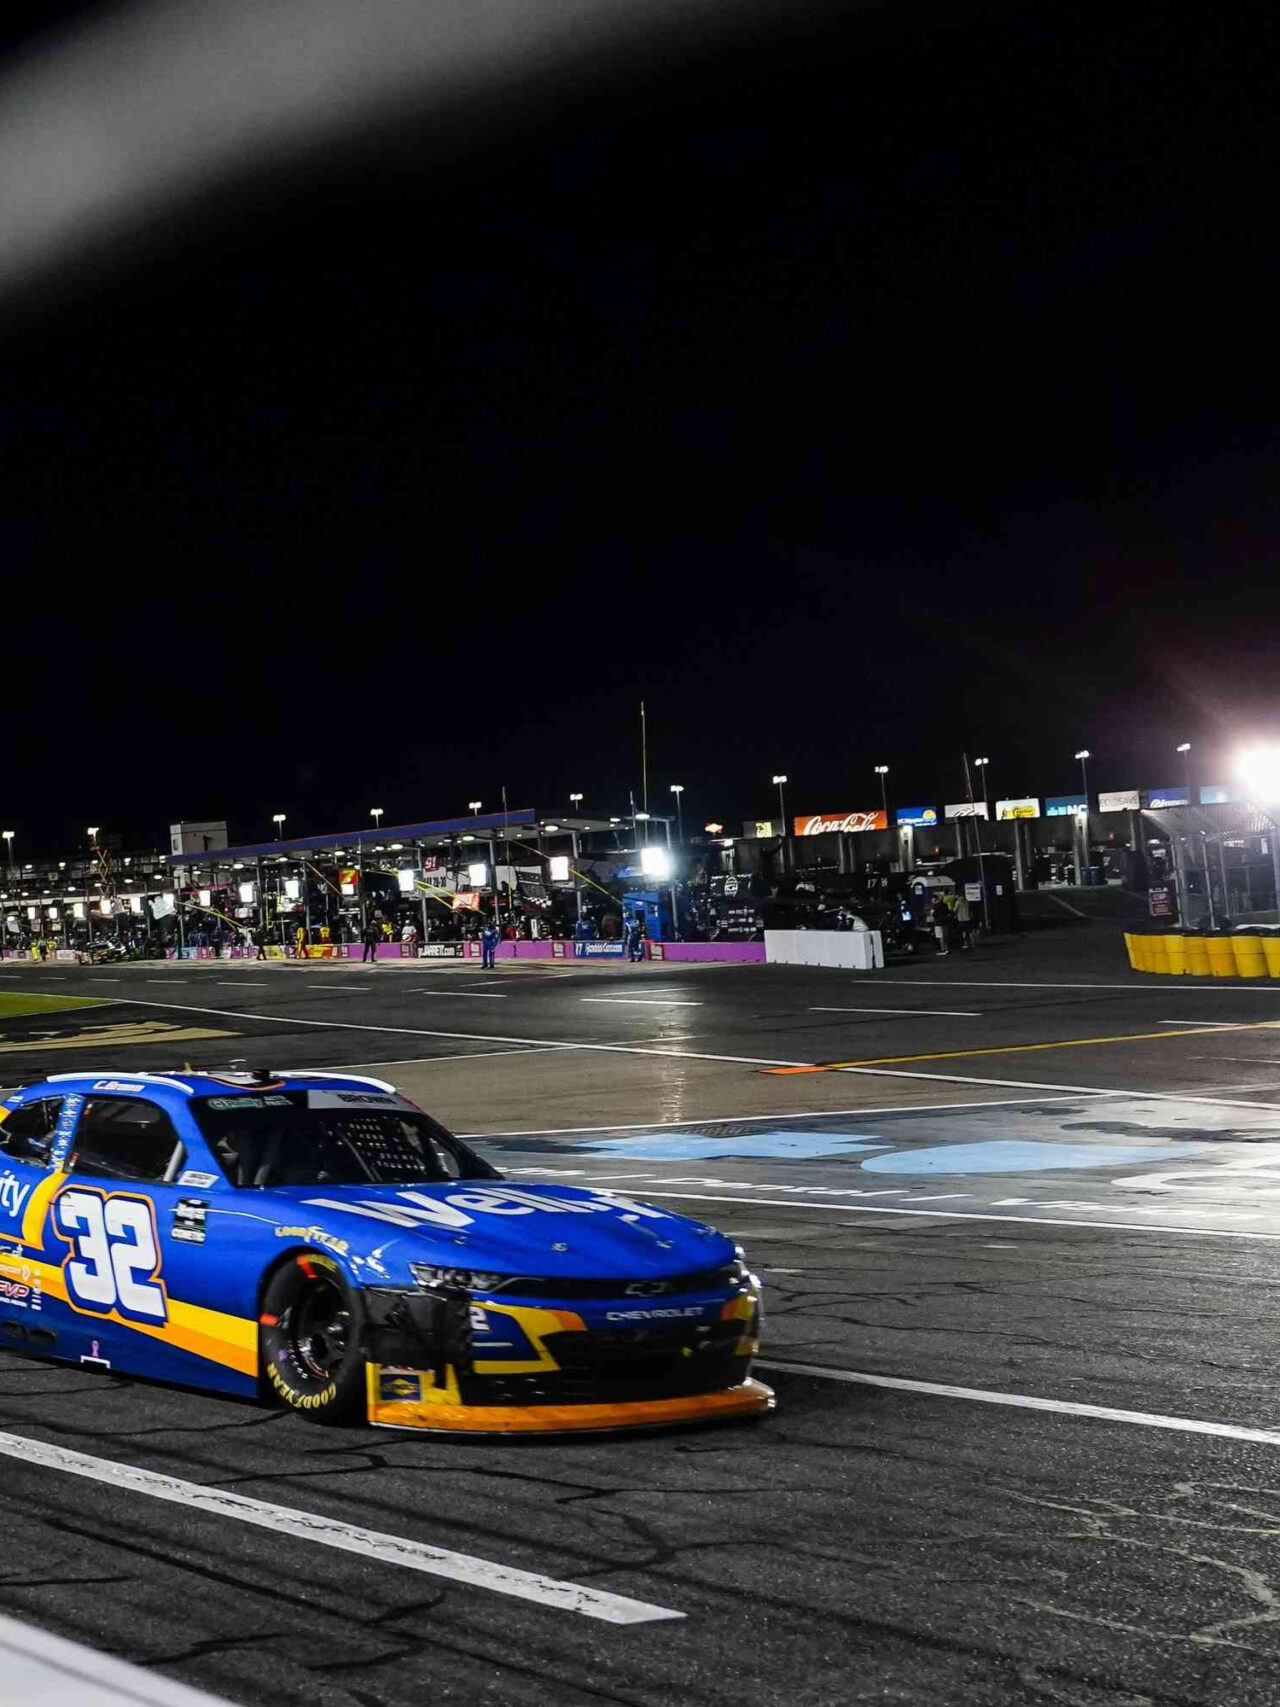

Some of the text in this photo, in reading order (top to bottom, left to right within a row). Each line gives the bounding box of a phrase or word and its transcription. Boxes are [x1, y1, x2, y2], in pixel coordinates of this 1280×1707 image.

[337, 1092, 398, 1105] BROWN
[58, 1190, 167, 1320] 32
[605, 1306, 706, 1321] CHEVROLET
[267, 1361, 337, 1409] GOODYEAR
